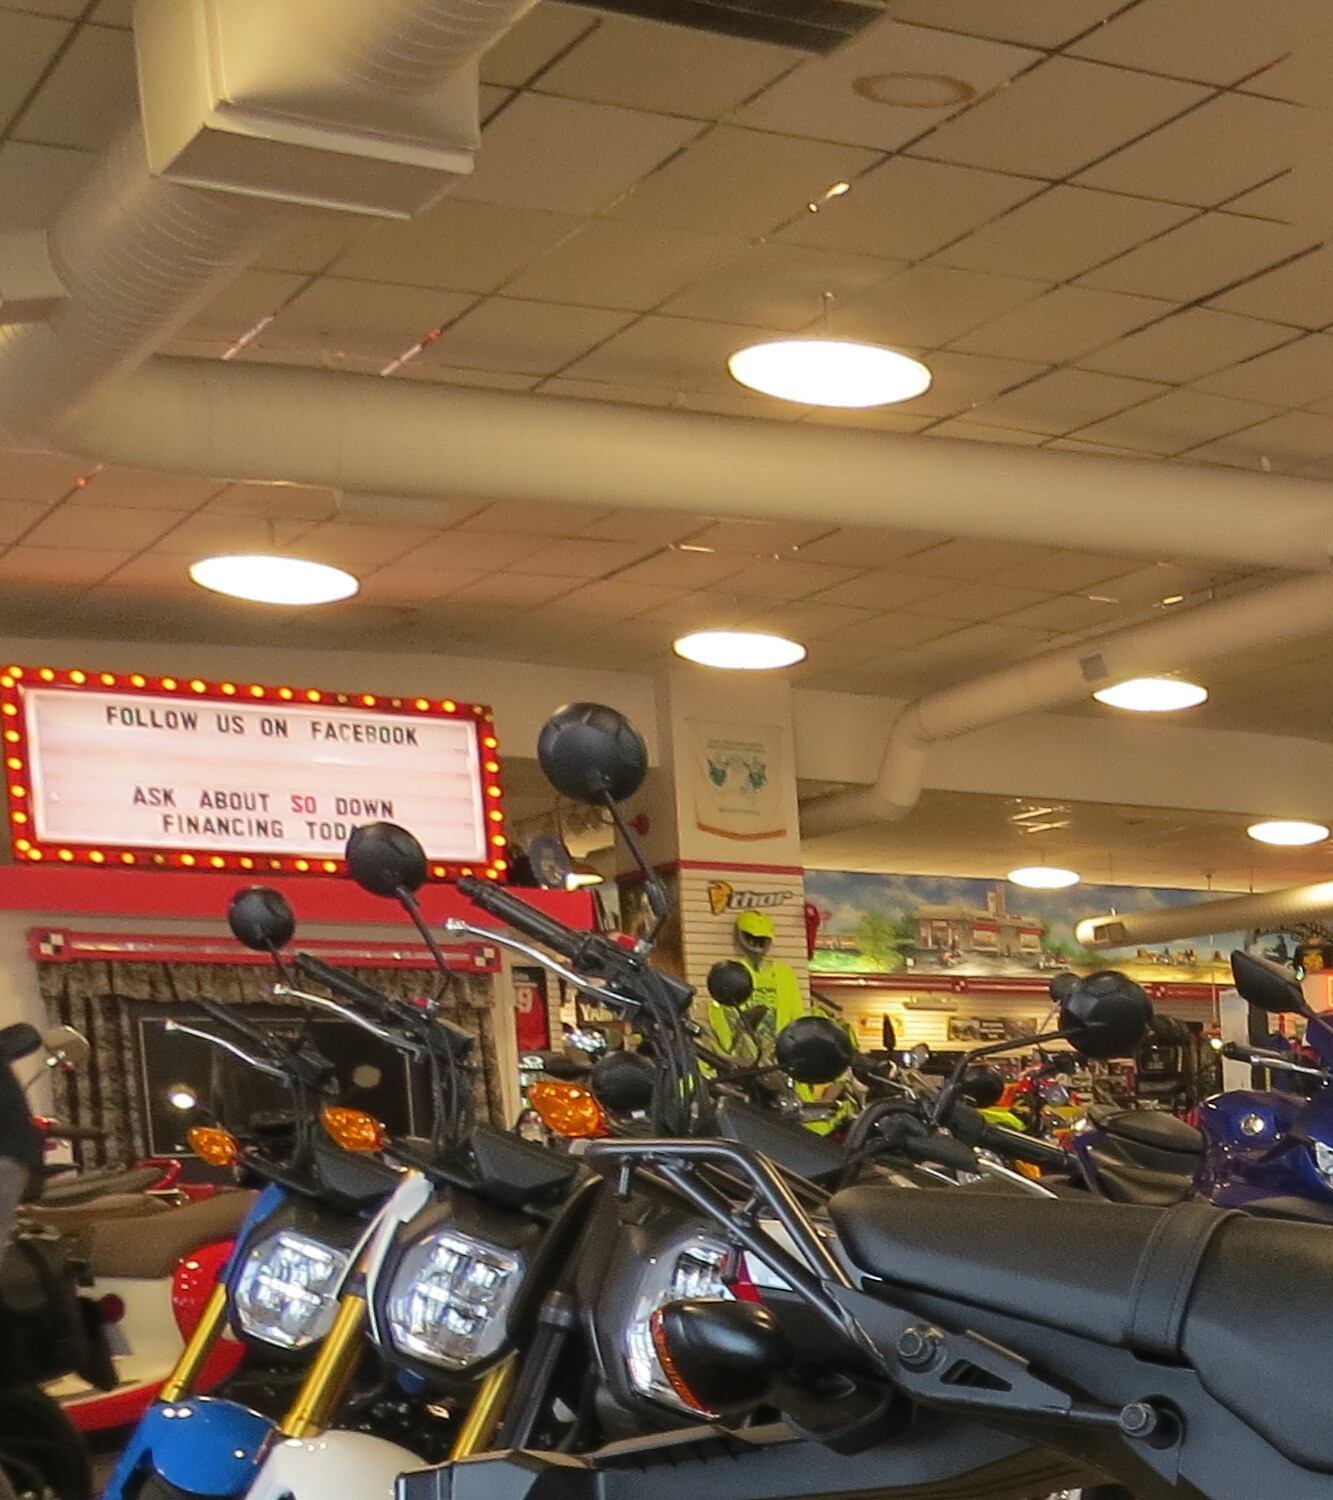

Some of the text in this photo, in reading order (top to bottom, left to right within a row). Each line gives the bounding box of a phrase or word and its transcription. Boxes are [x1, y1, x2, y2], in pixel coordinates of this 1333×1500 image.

[106, 706, 419, 747] FOLLOW US ON FACEBOOK
[133, 787, 176, 808] ASK
[200, 792, 270, 813] ABOUT
[336, 798, 395, 819] DOWN
[162, 814, 284, 838] FINANCING
